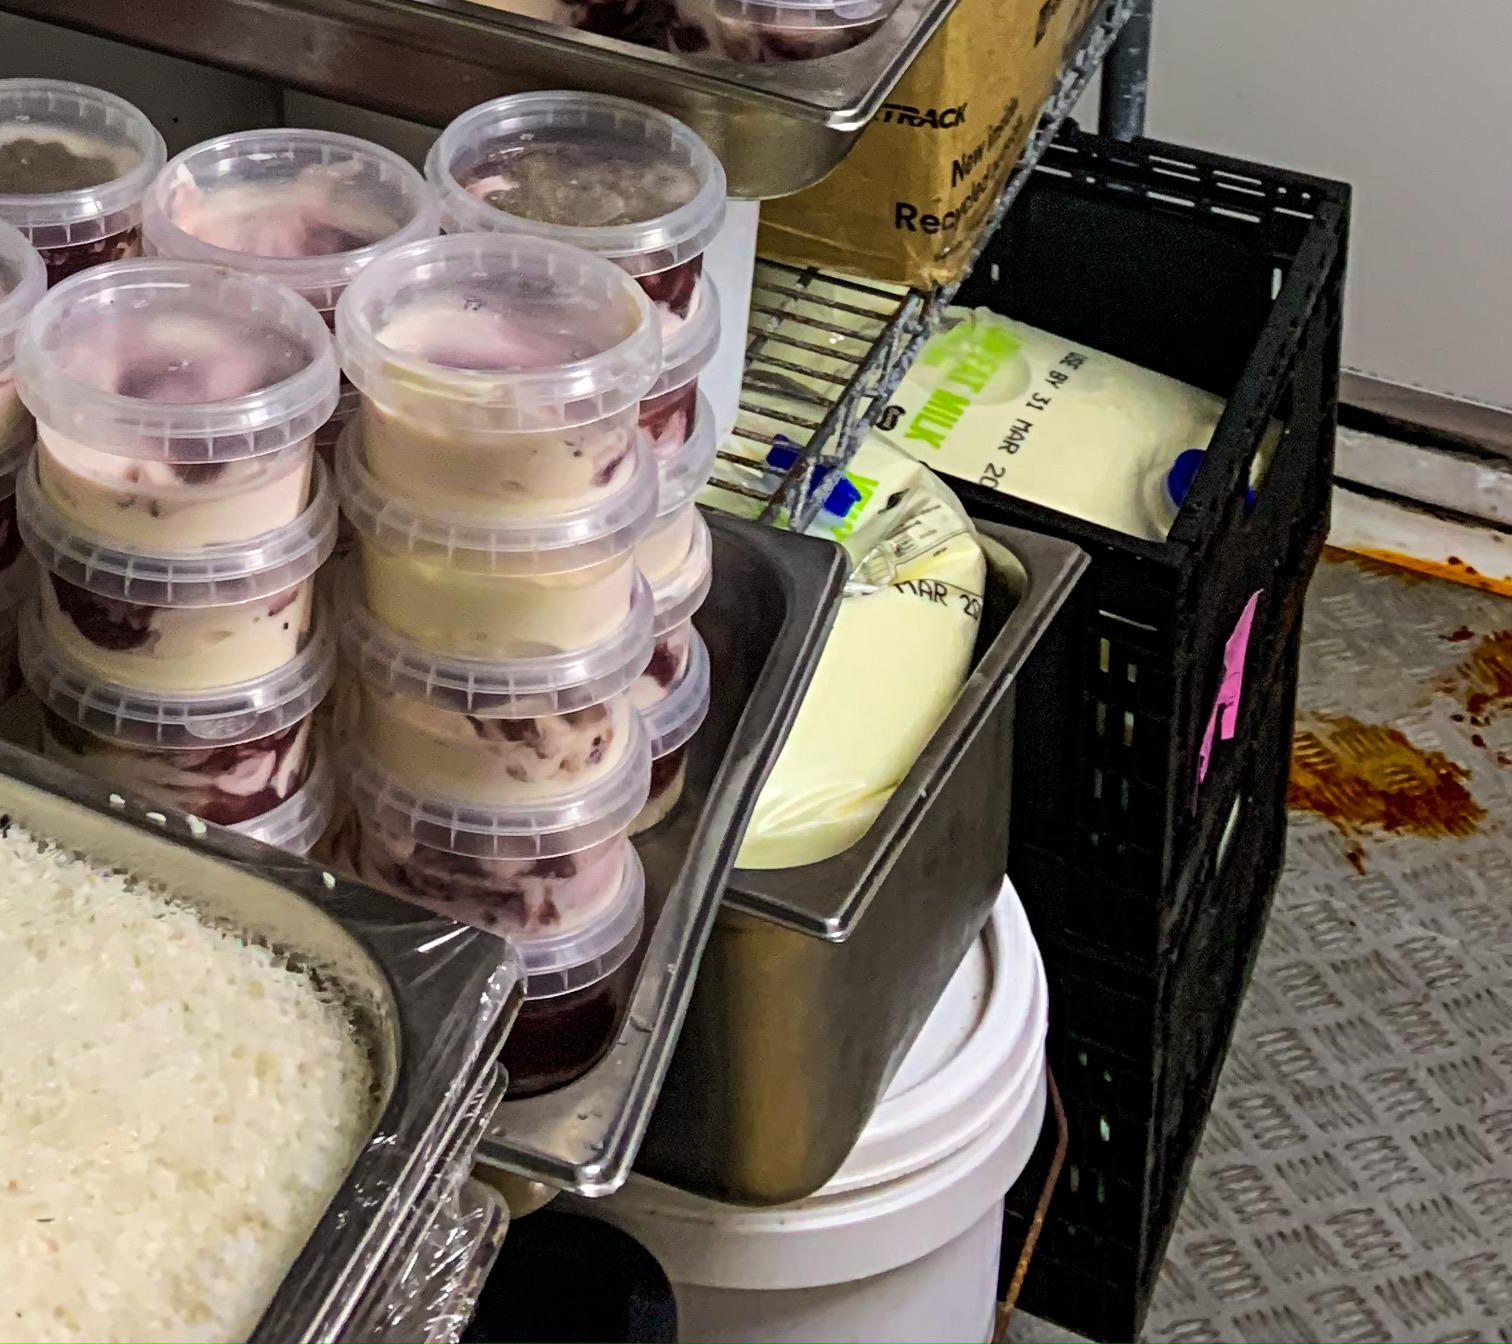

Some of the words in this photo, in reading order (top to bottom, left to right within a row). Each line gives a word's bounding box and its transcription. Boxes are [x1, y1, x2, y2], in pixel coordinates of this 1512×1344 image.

[874, 102, 968, 129] TRACK
[1045, 370, 1070, 389] BY
[1025, 392, 1053, 411] 31
[904, 387, 972, 450] MILK
[997, 418, 1034, 455] MAR
